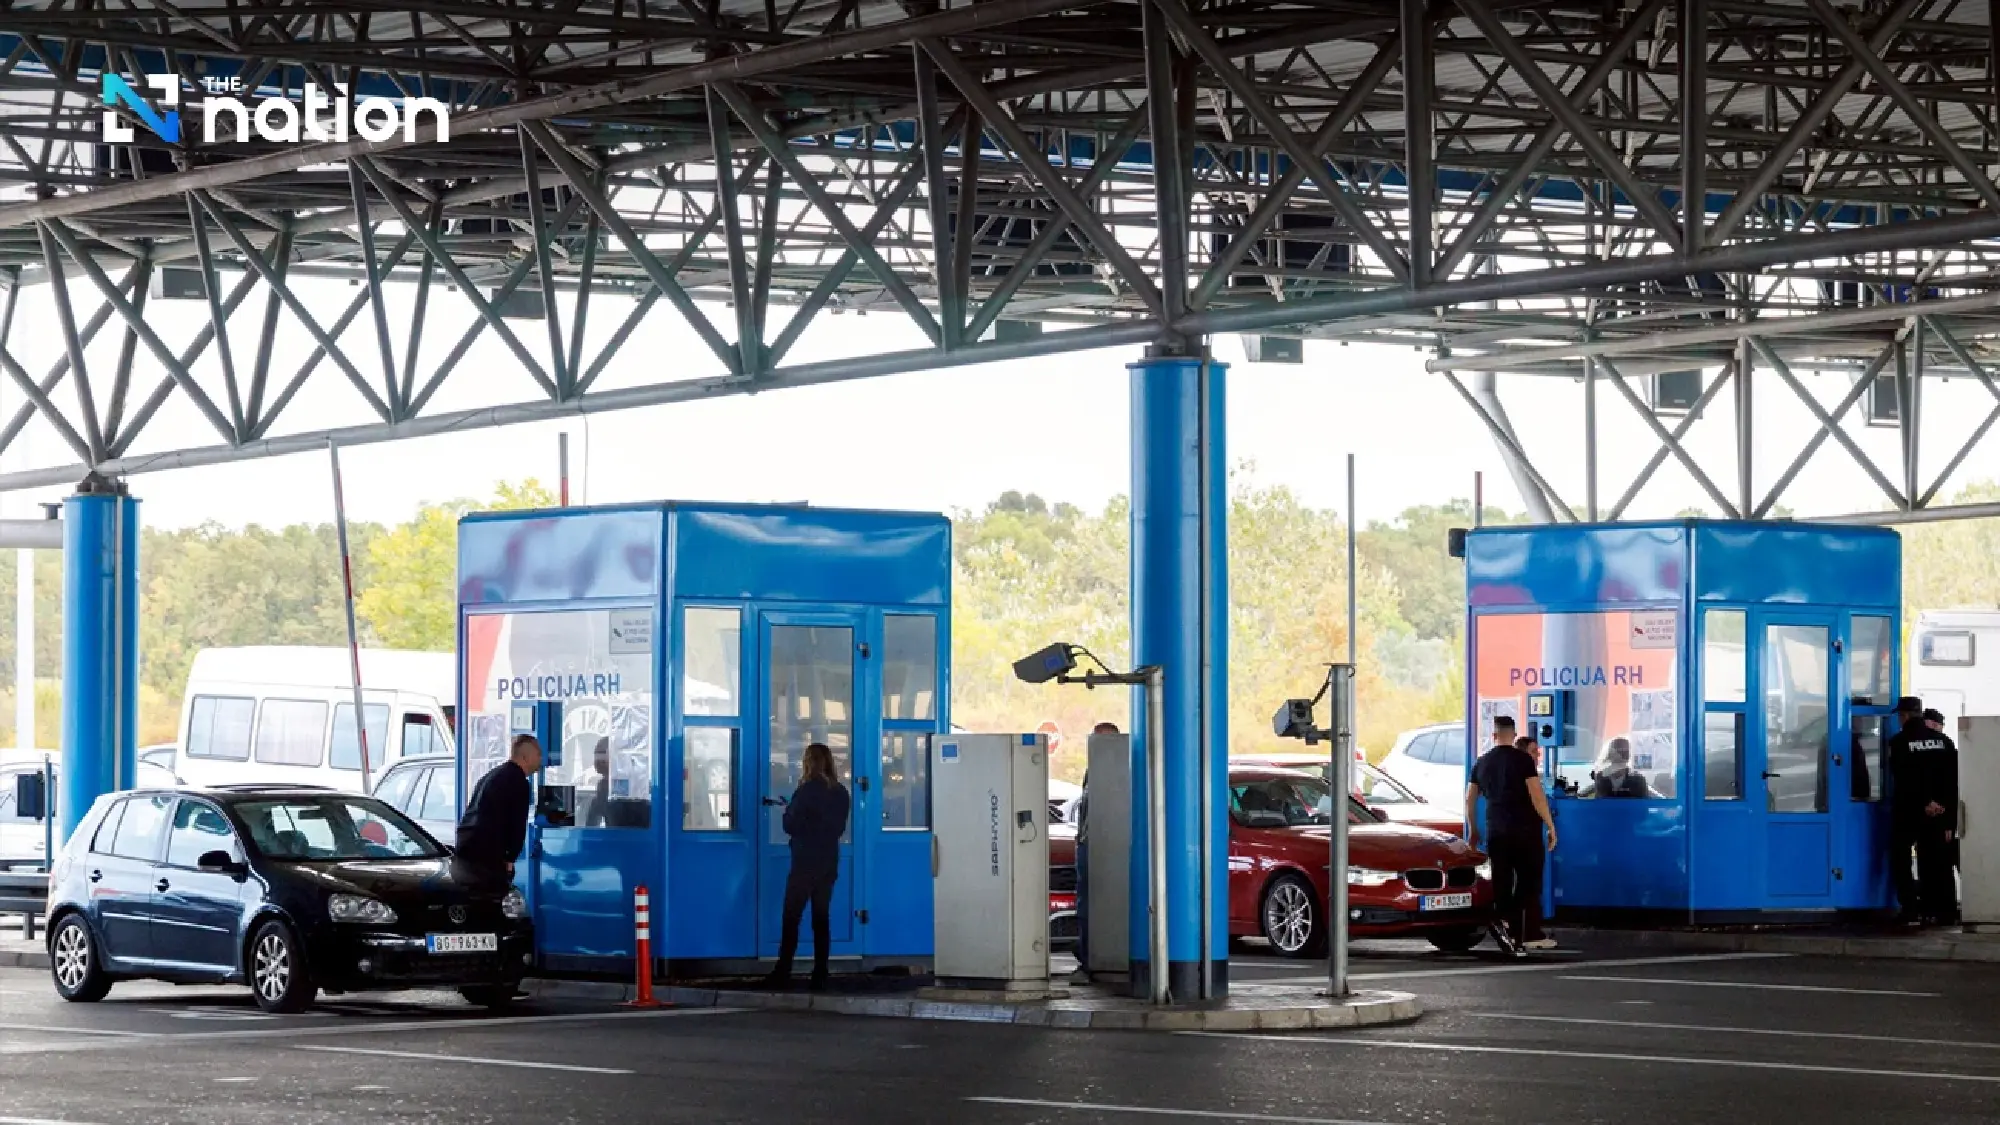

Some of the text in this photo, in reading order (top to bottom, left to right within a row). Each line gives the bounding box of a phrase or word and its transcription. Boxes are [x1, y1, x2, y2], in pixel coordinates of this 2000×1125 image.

[497, 673, 620, 700] POLICIJA RH
[1509, 665, 1643, 686] POLICIJA RH
